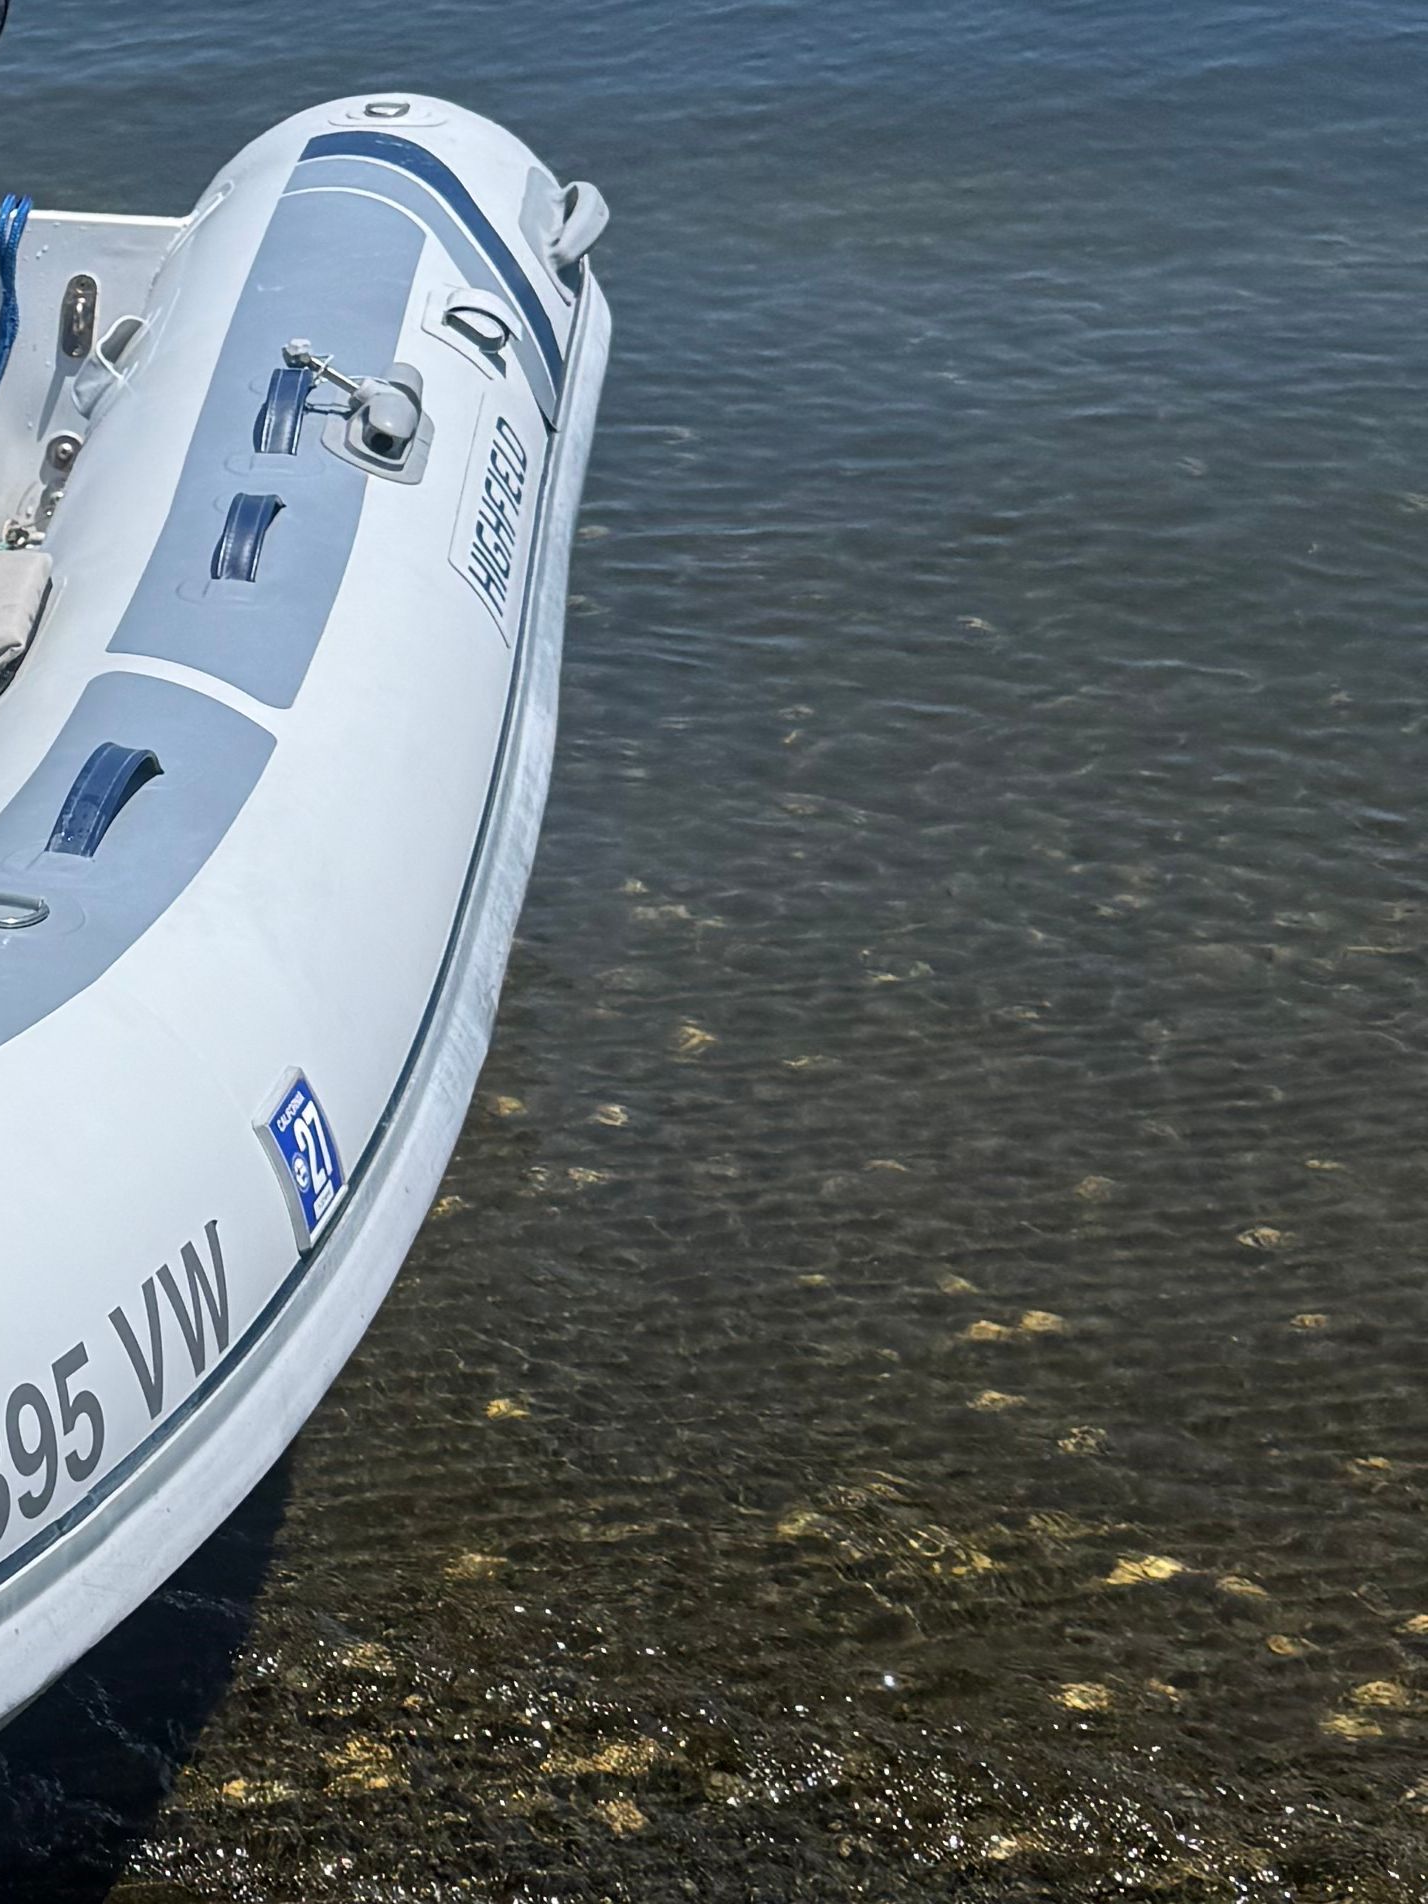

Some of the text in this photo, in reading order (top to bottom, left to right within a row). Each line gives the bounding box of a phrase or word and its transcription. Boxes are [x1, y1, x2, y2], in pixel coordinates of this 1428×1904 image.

[468, 415, 527, 618] HIGHFIELD
[294, 1099, 334, 1195] 27
[107, 1218, 230, 1421] VW
